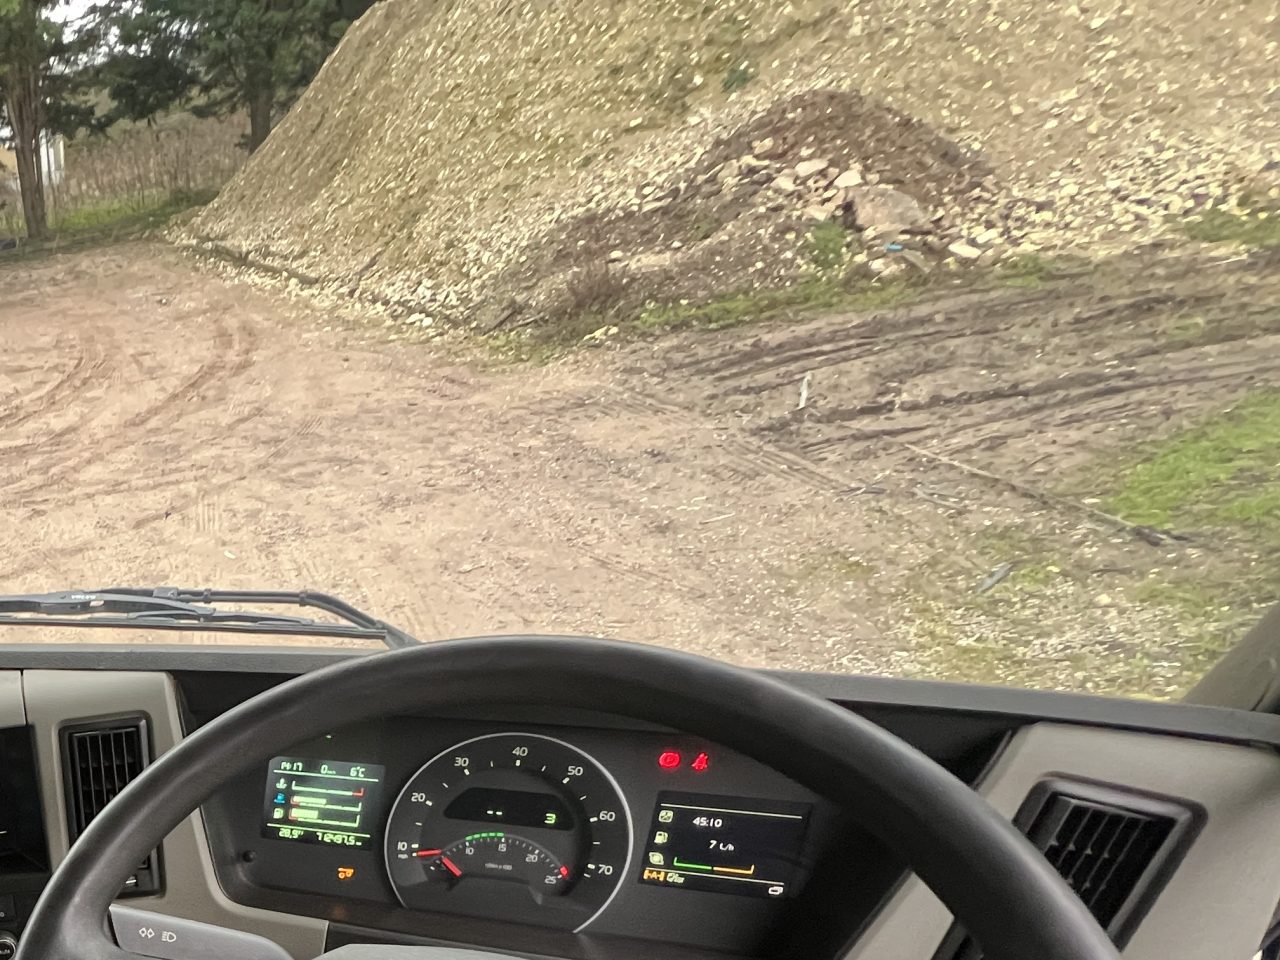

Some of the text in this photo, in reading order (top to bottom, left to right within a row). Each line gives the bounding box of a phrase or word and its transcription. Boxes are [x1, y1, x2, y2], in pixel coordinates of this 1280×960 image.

[511, 746, 528, 757] 40
[453, 756, 470, 767] 30
[567, 766, 584, 777] 50
[410, 792, 426, 803] 20
[544, 813, 556, 825] 3
[599, 811, 616, 822] 60
[692, 816, 723, 828] 45:10
[397, 841, 408, 851] 10
[497, 842, 508, 852] 15
[709, 840, 718, 849] 7
[464, 846, 475, 856] 10
[525, 854, 538, 864] 20
[597, 864, 613, 875] 70
[544, 875, 557, 885] 25
